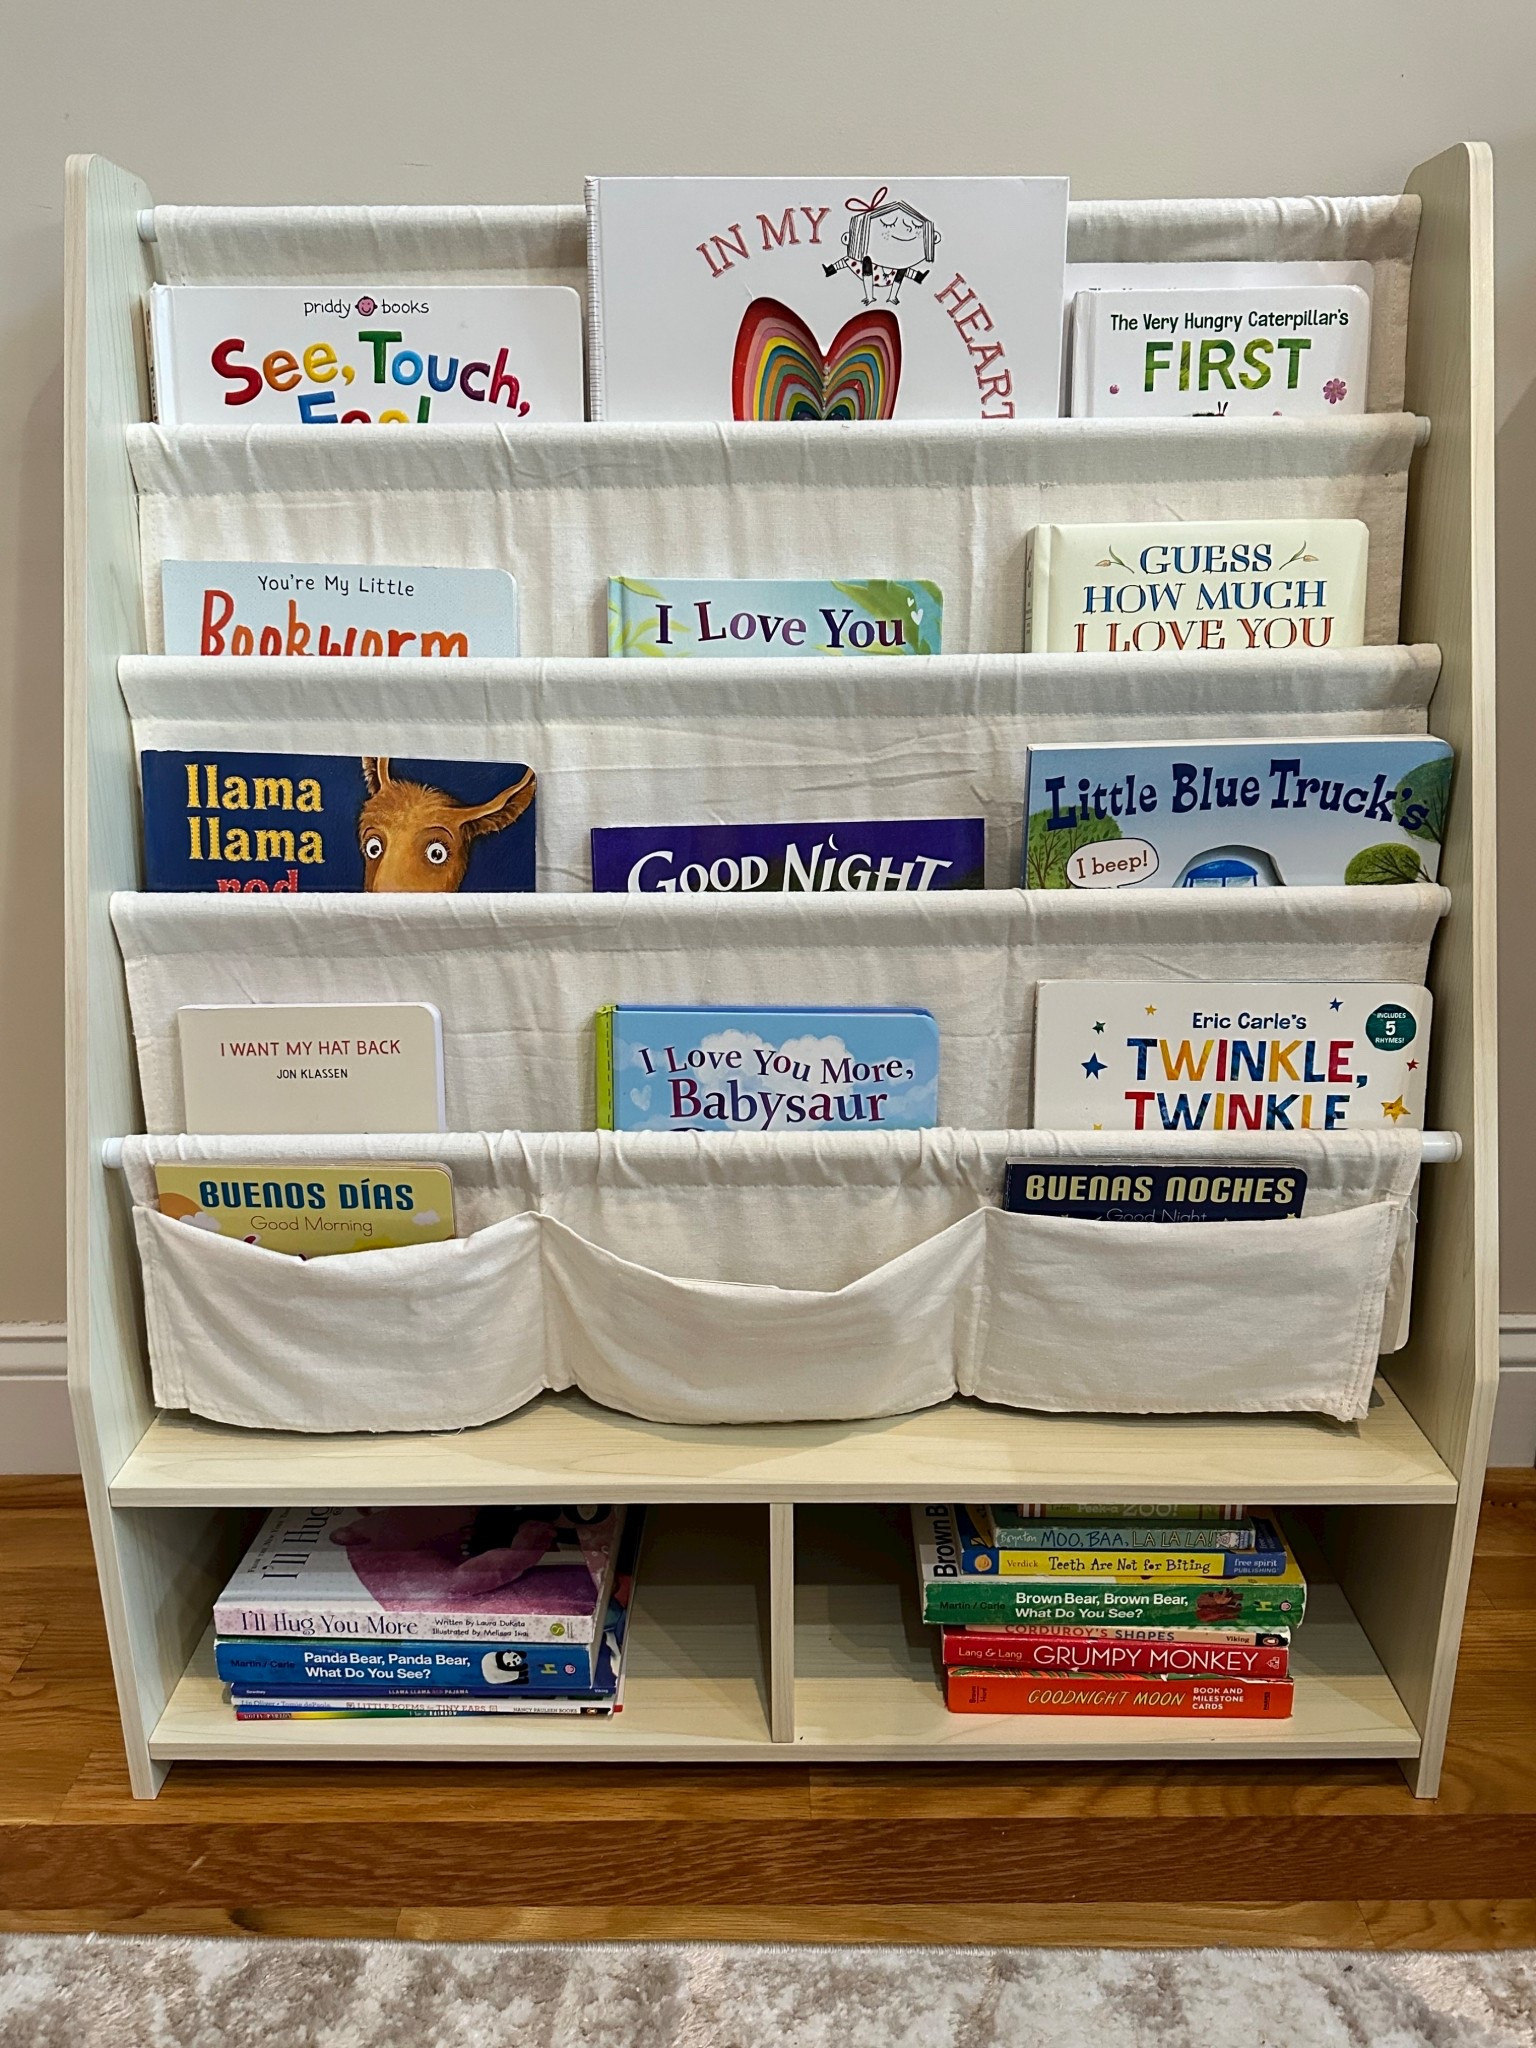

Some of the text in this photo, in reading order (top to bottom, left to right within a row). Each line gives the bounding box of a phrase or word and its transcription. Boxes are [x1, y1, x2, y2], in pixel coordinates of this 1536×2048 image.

[696, 206, 832, 279] IN MY
[304, 300, 430, 319] priddy books
[1110, 309, 1349, 333] The Very Hungry Caterpillar's
[934, 273, 1016, 420] HEART
[211, 338, 355, 406] See,
[358, 330, 531, 417] Touch,
[1144, 338, 1312, 393] FIRST
[1140, 543, 1273, 574] GUESS
[257, 574, 415, 597] You're My Little
[1082, 579, 1328, 614] HOW MUCH
[201, 589, 470, 658] Bookworm
[655, 600, 907, 648] I Love You
[1074, 616, 1335, 652] I LOVE YOU
[184, 763, 325, 813] llama
[1045, 758, 1430, 832] Little Blue Truck's
[186, 816, 326, 865] llama
[627, 850, 769, 892] GOOD
[1076, 849, 1149, 880] I beep!
[1193, 1011, 1307, 1030] Eric Carle's
[1385, 1020, 1396, 1036] 5
[220, 1039, 401, 1057] I WANT MY HAT BACK
[276, 1068, 348, 1079] JON KLASSEN
[638, 1046, 914, 1085] I Love You More,
[1127, 1038, 1368, 1088] TWINKLE,
[667, 1078, 888, 1131] Babysaur
[1124, 1091, 1350, 1131] TWINKLE
[199, 1177, 414, 1211] BUENOS DÍAS
[1025, 1174, 1296, 1204] BUENAS NOCHES
[250, 1215, 373, 1237] Good Morning
[1106, 1208, 1156, 1222] Good
[933, 1520, 958, 1577] Brown
[1040, 1530, 1215, 1548] MOO, BAA, LA LA LA!
[1007, 1559, 1039, 1567] Verdick
[1049, 1556, 1211, 1574] Teeth Are Not for Biting
[1234, 1558, 1278, 1569] free spirit
[940, 1602, 971, 1610] Martin
[980, 1602, 1006, 1610] Carle
[1016, 1592, 1189, 1606] Brown Bear, Brown Bear,
[241, 1611, 419, 1636] I'll Hug You More
[434, 1618, 463, 1626] Written
[465, 1619, 475, 1627] by
[476, 1619, 497, 1627] Laura
[1015, 1608, 1144, 1618] What Do You See?
[432, 1628, 469, 1636] Illustrated
[472, 1629, 481, 1637] by
[484, 1629, 512, 1637] Melissa
[1005, 1625, 1175, 1641] CORDUROY'S SHAPES
[1226, 1635, 1250, 1644] Viking
[230, 1659, 262, 1668] Martin
[269, 1660, 296, 1669] Carle
[304, 1651, 471, 1667] Panda Bear, Panda Bear,
[958, 1647, 1023, 1659] Lang & Lang
[1033, 1645, 1259, 1671] GRUMPY MONKEY
[305, 1667, 431, 1679] What Do You See?
[1028, 1689, 1187, 1706] GOODNIGHT MOON
[1222, 1687, 1244, 1695] AND
[392, 1703, 425, 1711] POEMS
